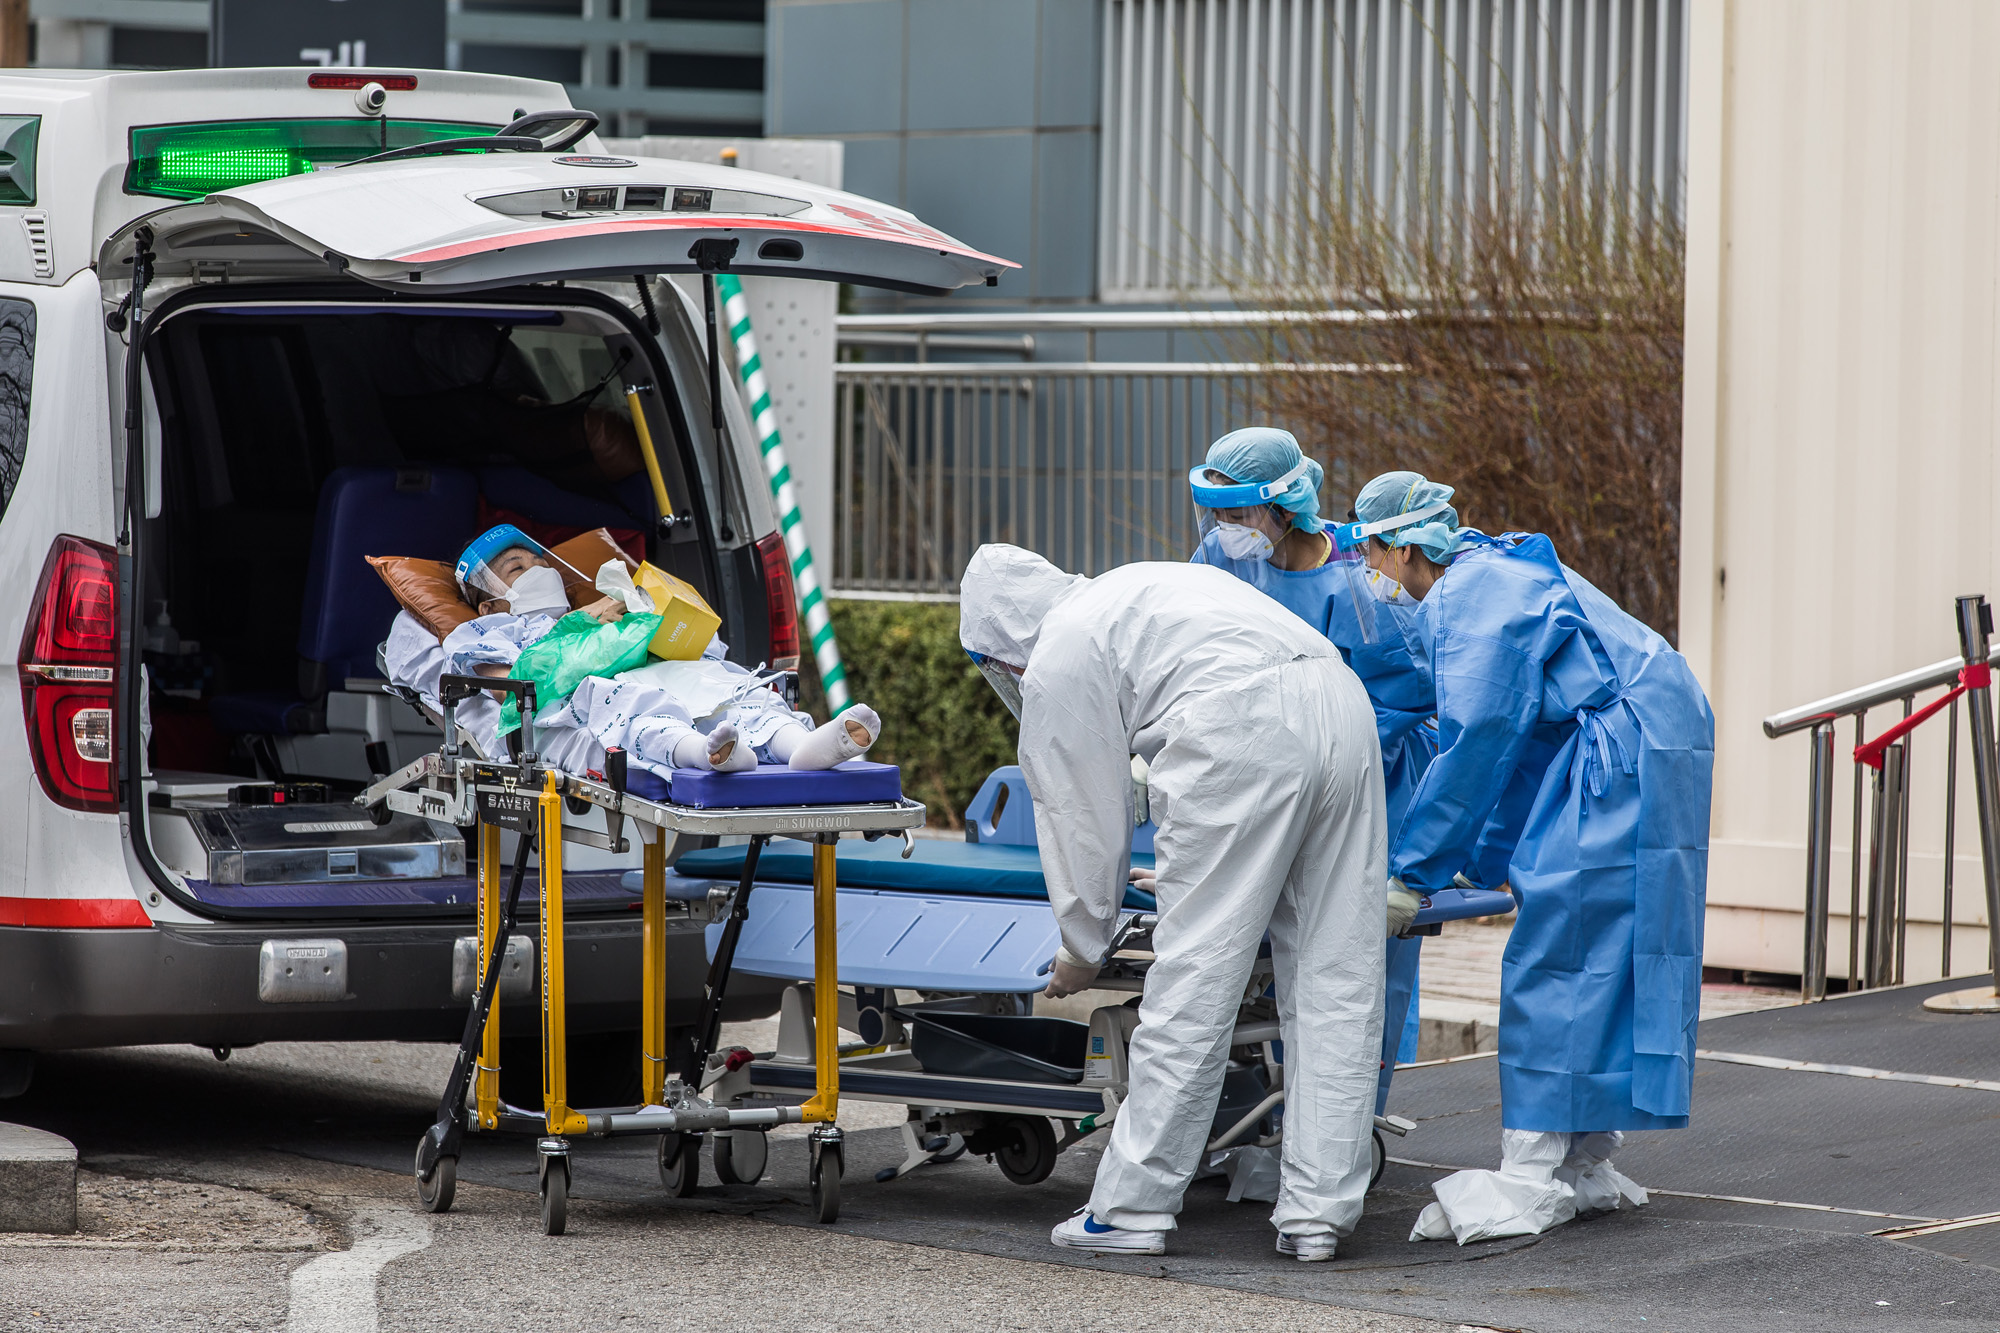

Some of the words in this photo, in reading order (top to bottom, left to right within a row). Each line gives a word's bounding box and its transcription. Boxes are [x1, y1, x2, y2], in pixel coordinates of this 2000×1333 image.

[484, 527, 508, 543] FACE
[488, 794, 531, 812] SAVER
[313, 822, 364, 832] SUNGWOO
[792, 816, 850, 829] SUNGWOO
